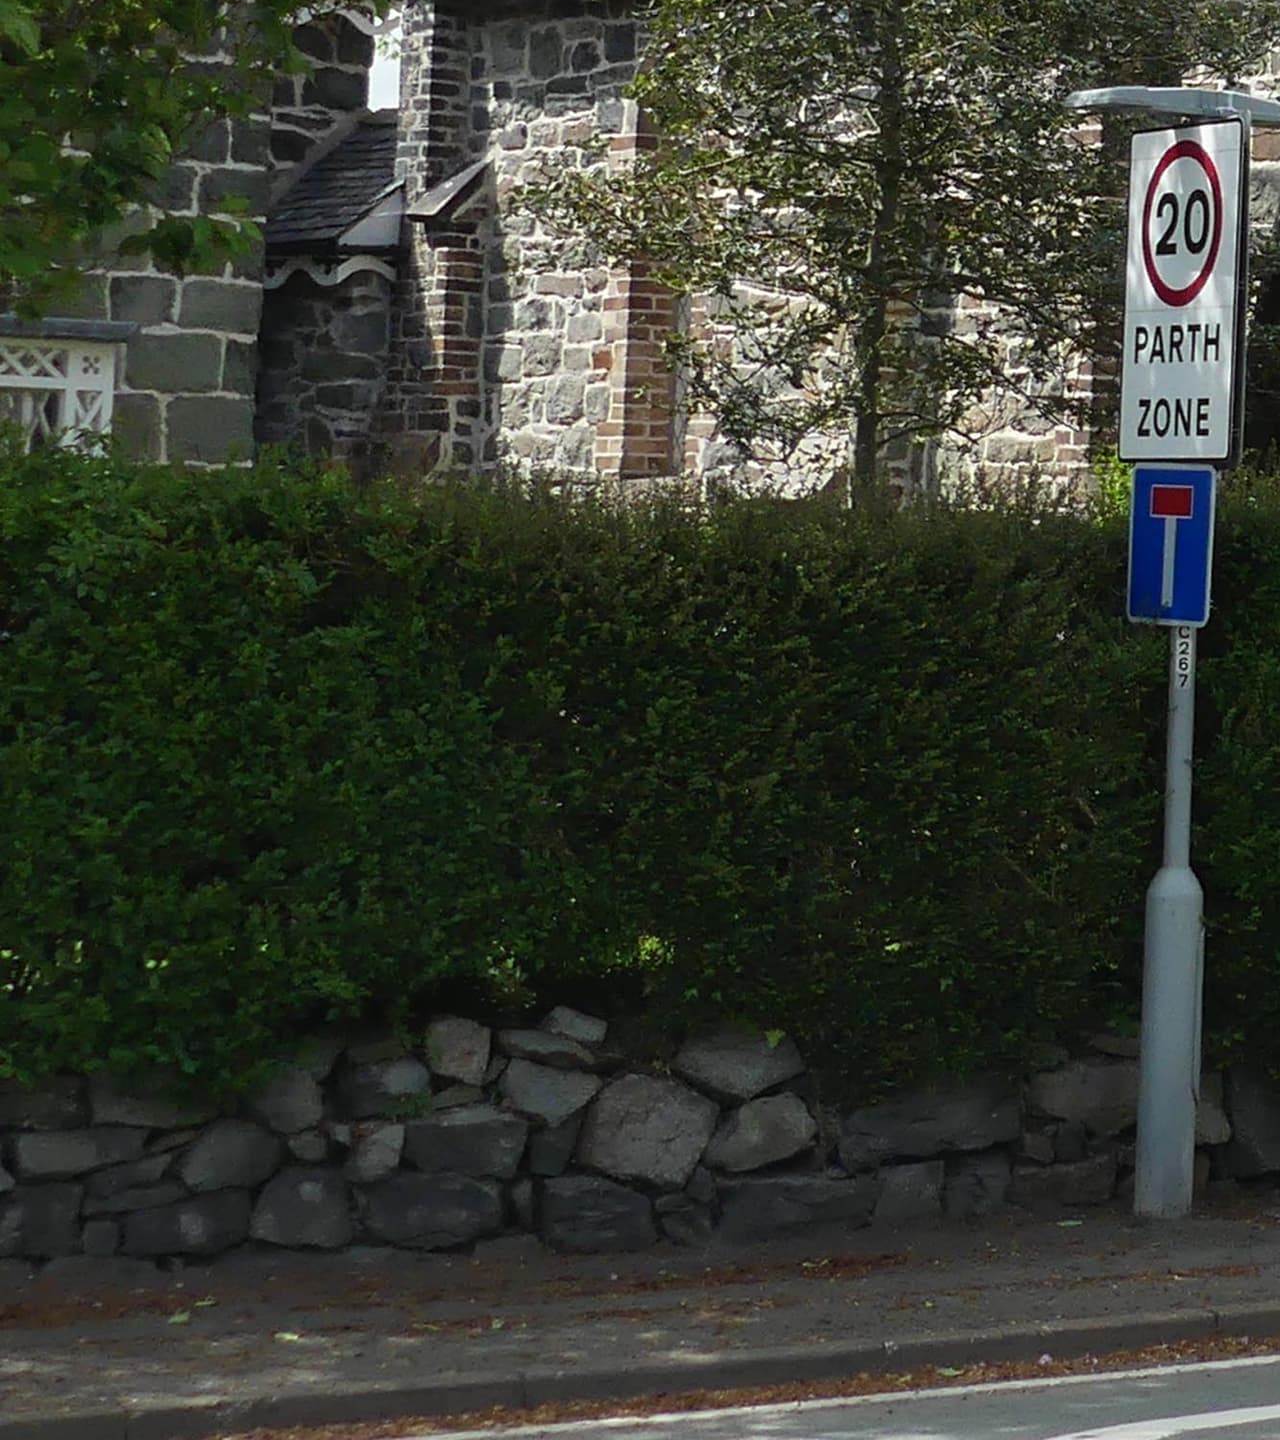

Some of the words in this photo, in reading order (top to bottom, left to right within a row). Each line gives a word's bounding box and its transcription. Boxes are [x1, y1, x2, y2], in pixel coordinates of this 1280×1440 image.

[1155, 188, 1210, 256] 20
[1133, 323, 1221, 364] PARTH
[1137, 398, 1210, 437] ZONE
[1178, 625, 1191, 688] C267
